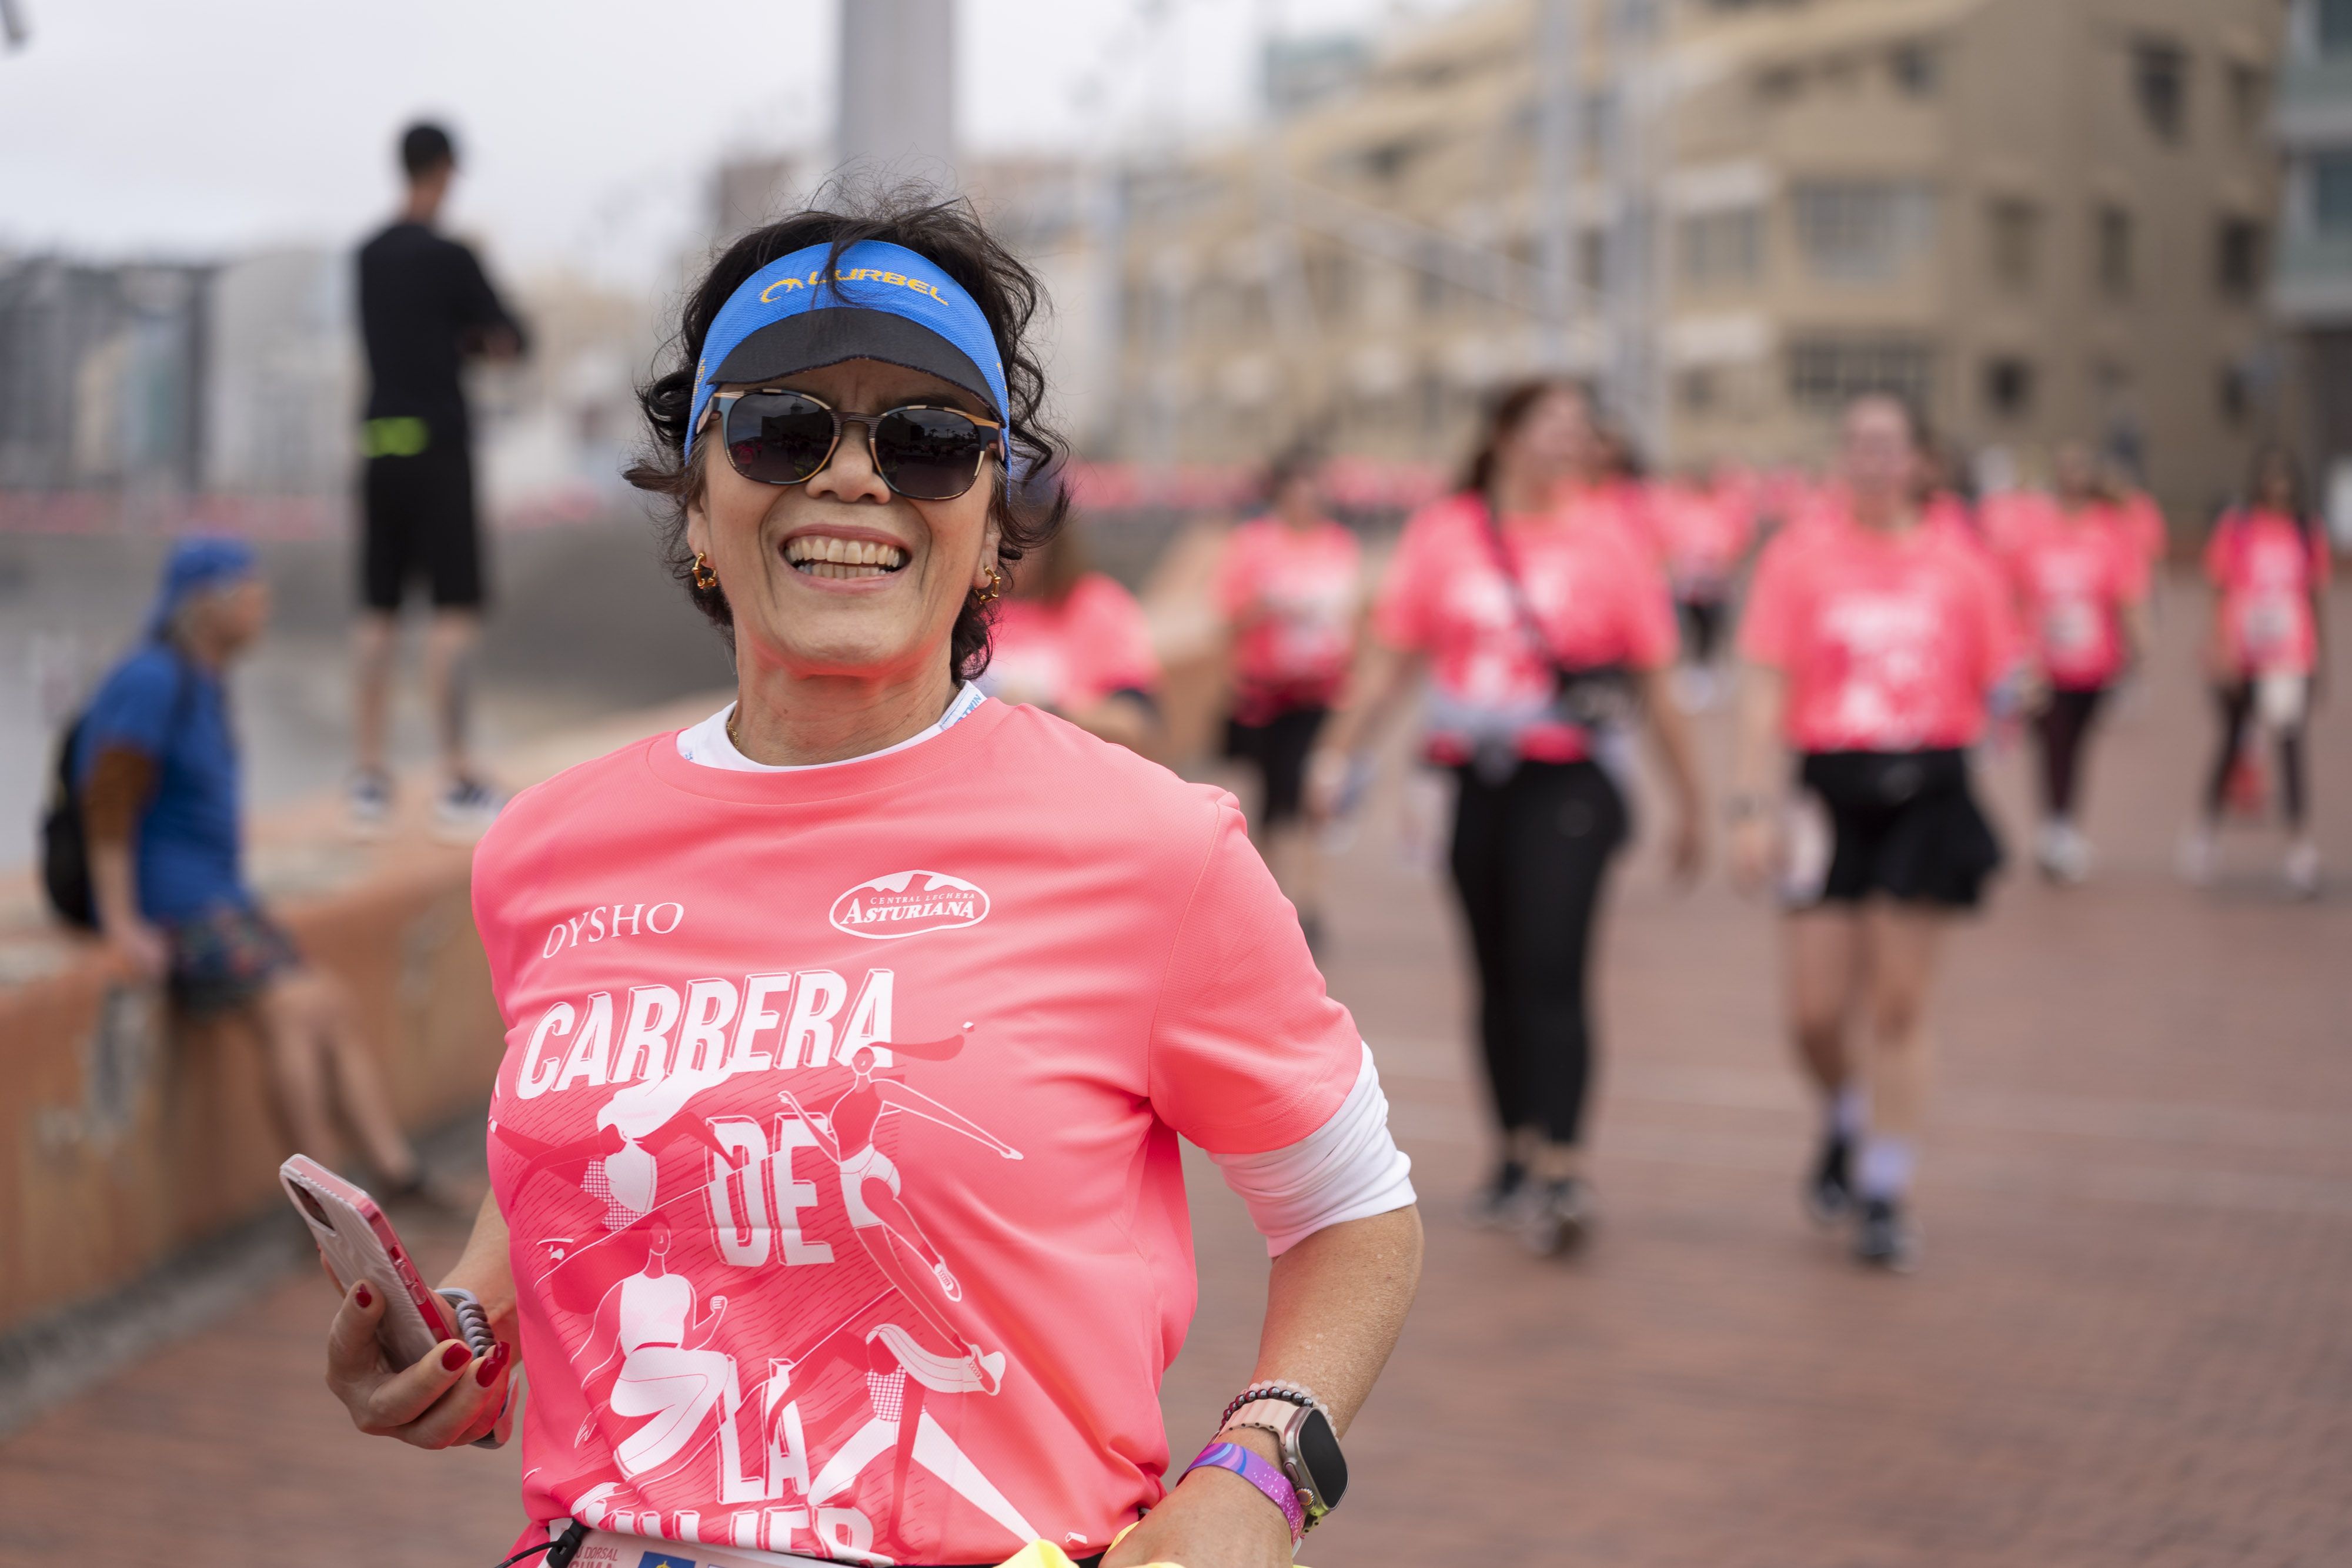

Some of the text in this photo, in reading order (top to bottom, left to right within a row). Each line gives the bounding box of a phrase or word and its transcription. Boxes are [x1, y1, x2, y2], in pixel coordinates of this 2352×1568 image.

[808, 268, 949, 306] LURBEL
[839, 898, 975, 925] ASTURIANA
[870, 892, 975, 905] CENTRAL LECHERA
[542, 902, 684, 959] OYSHO
[516, 968, 894, 1099] CARRERA
[702, 1112, 836, 1267] DE
[715, 1354, 810, 1505] LA
[584, 1546, 618, 1562] DORSAL
